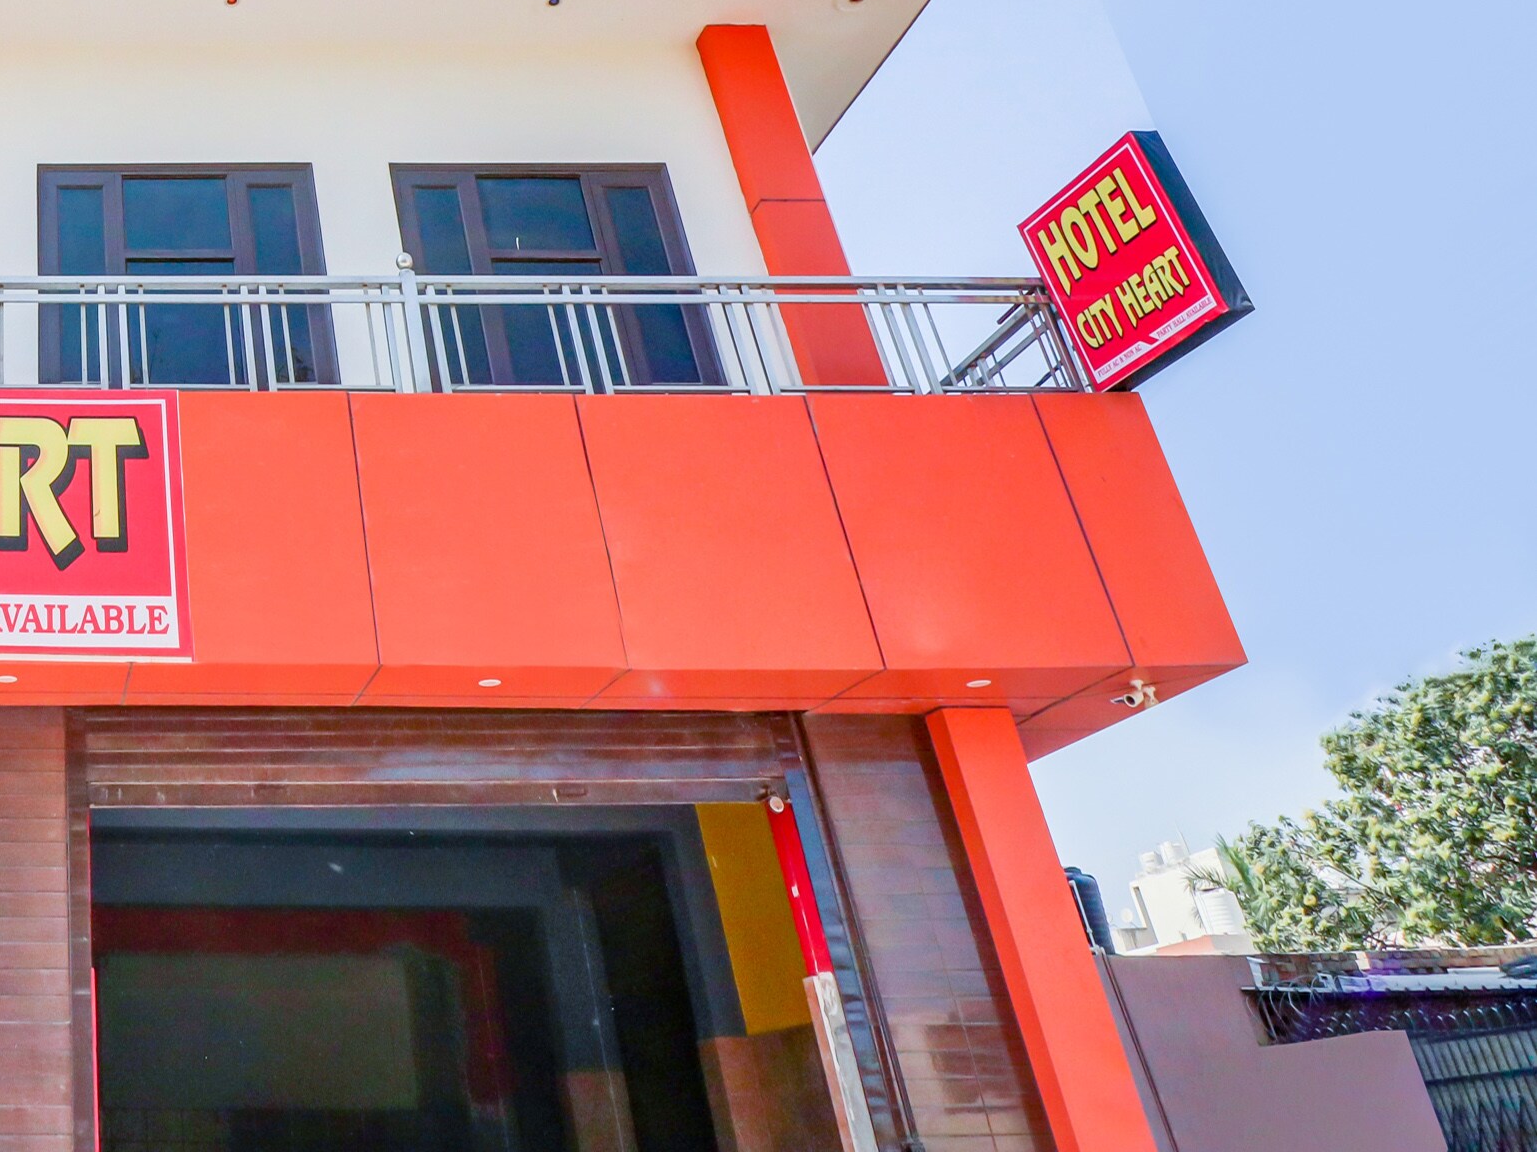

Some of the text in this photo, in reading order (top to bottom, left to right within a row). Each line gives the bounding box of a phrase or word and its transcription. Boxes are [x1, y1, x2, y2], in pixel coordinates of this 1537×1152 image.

[1037, 167, 1157, 296] HOTEL
[1076, 245, 1191, 348] CITY HEART
[1155, 324, 1173, 339] PARTY
